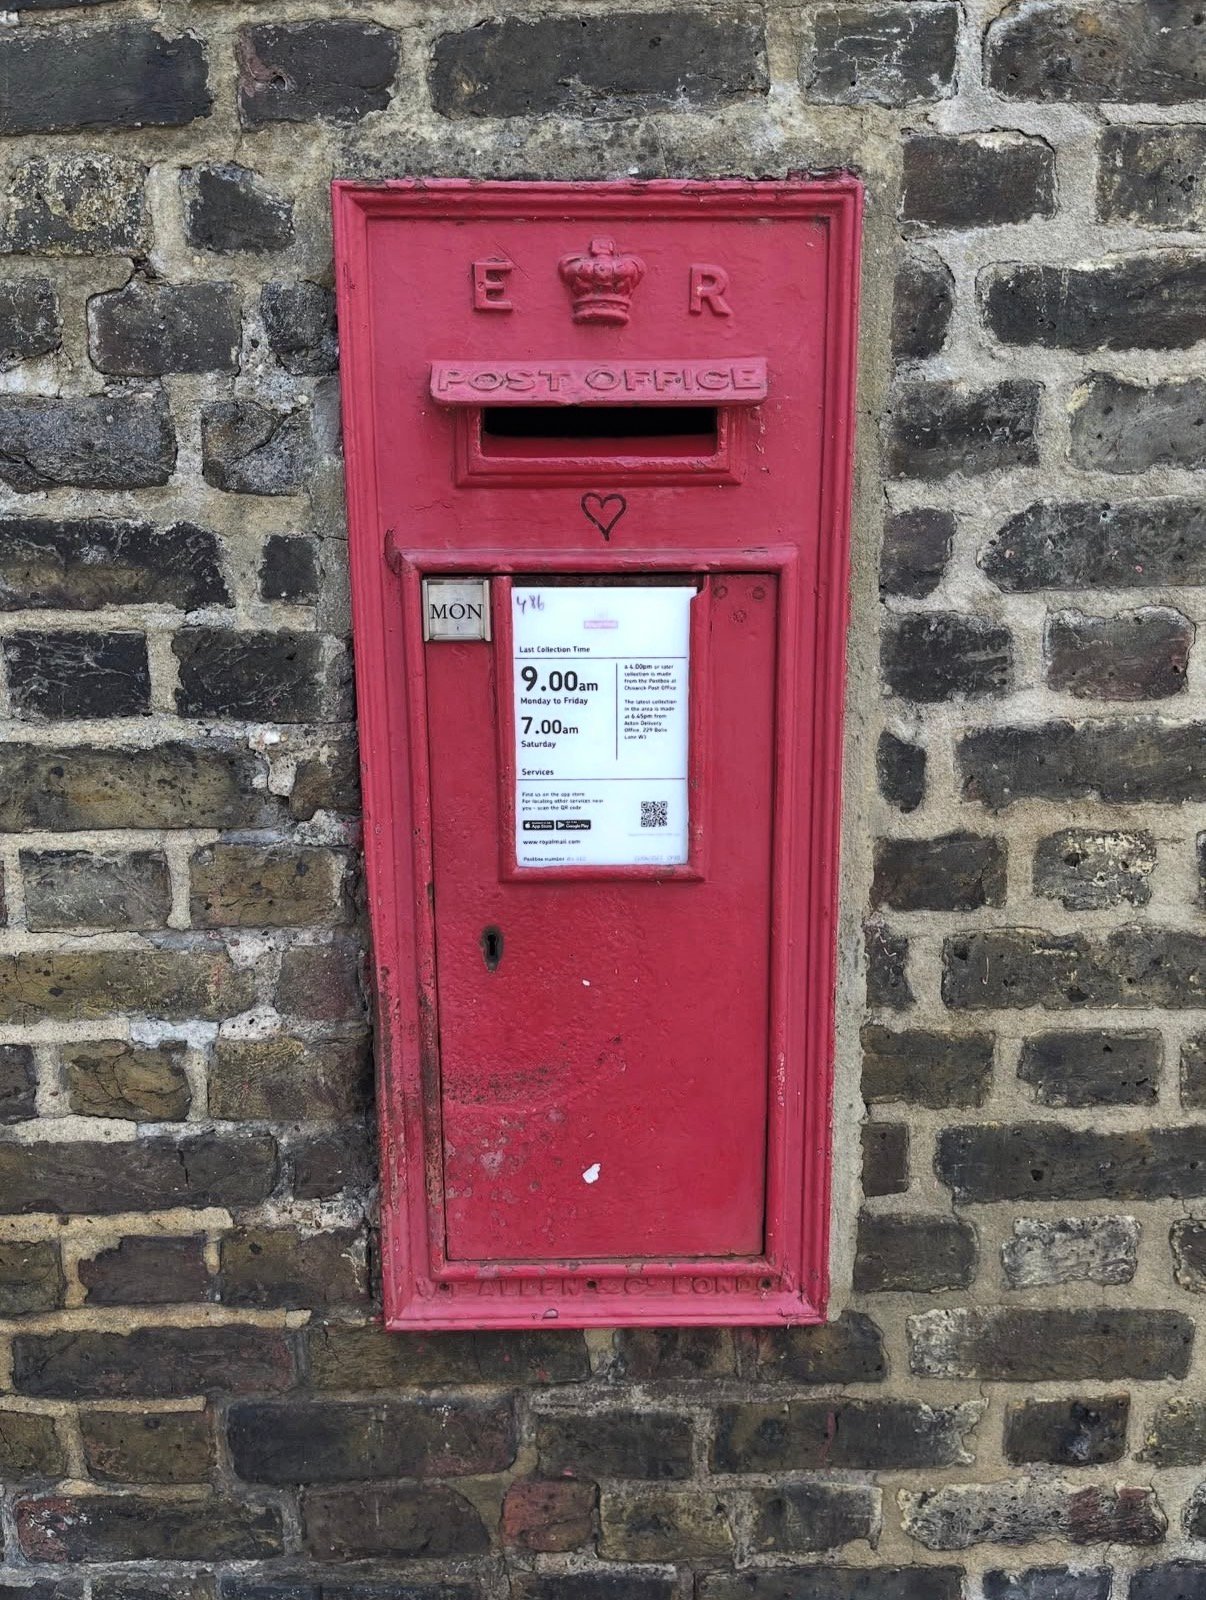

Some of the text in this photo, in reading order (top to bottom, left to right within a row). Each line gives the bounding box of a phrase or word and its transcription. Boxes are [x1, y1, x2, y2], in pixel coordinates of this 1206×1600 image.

[472, 259, 733, 314] E R
[436, 365, 762, 393] POST OFFICE
[430, 602, 483, 620] MON
[519, 645, 591, 653] Last Collection Time
[521, 666, 598, 692] 9.00am
[520, 696, 550, 706] Monday
[564, 696, 588, 706] Friday
[521, 716, 579, 735] 7.00am
[521, 740, 556, 749] Saturday
[521, 768, 555, 776] Services
[522, 838, 581, 846] www.royalmail.com
